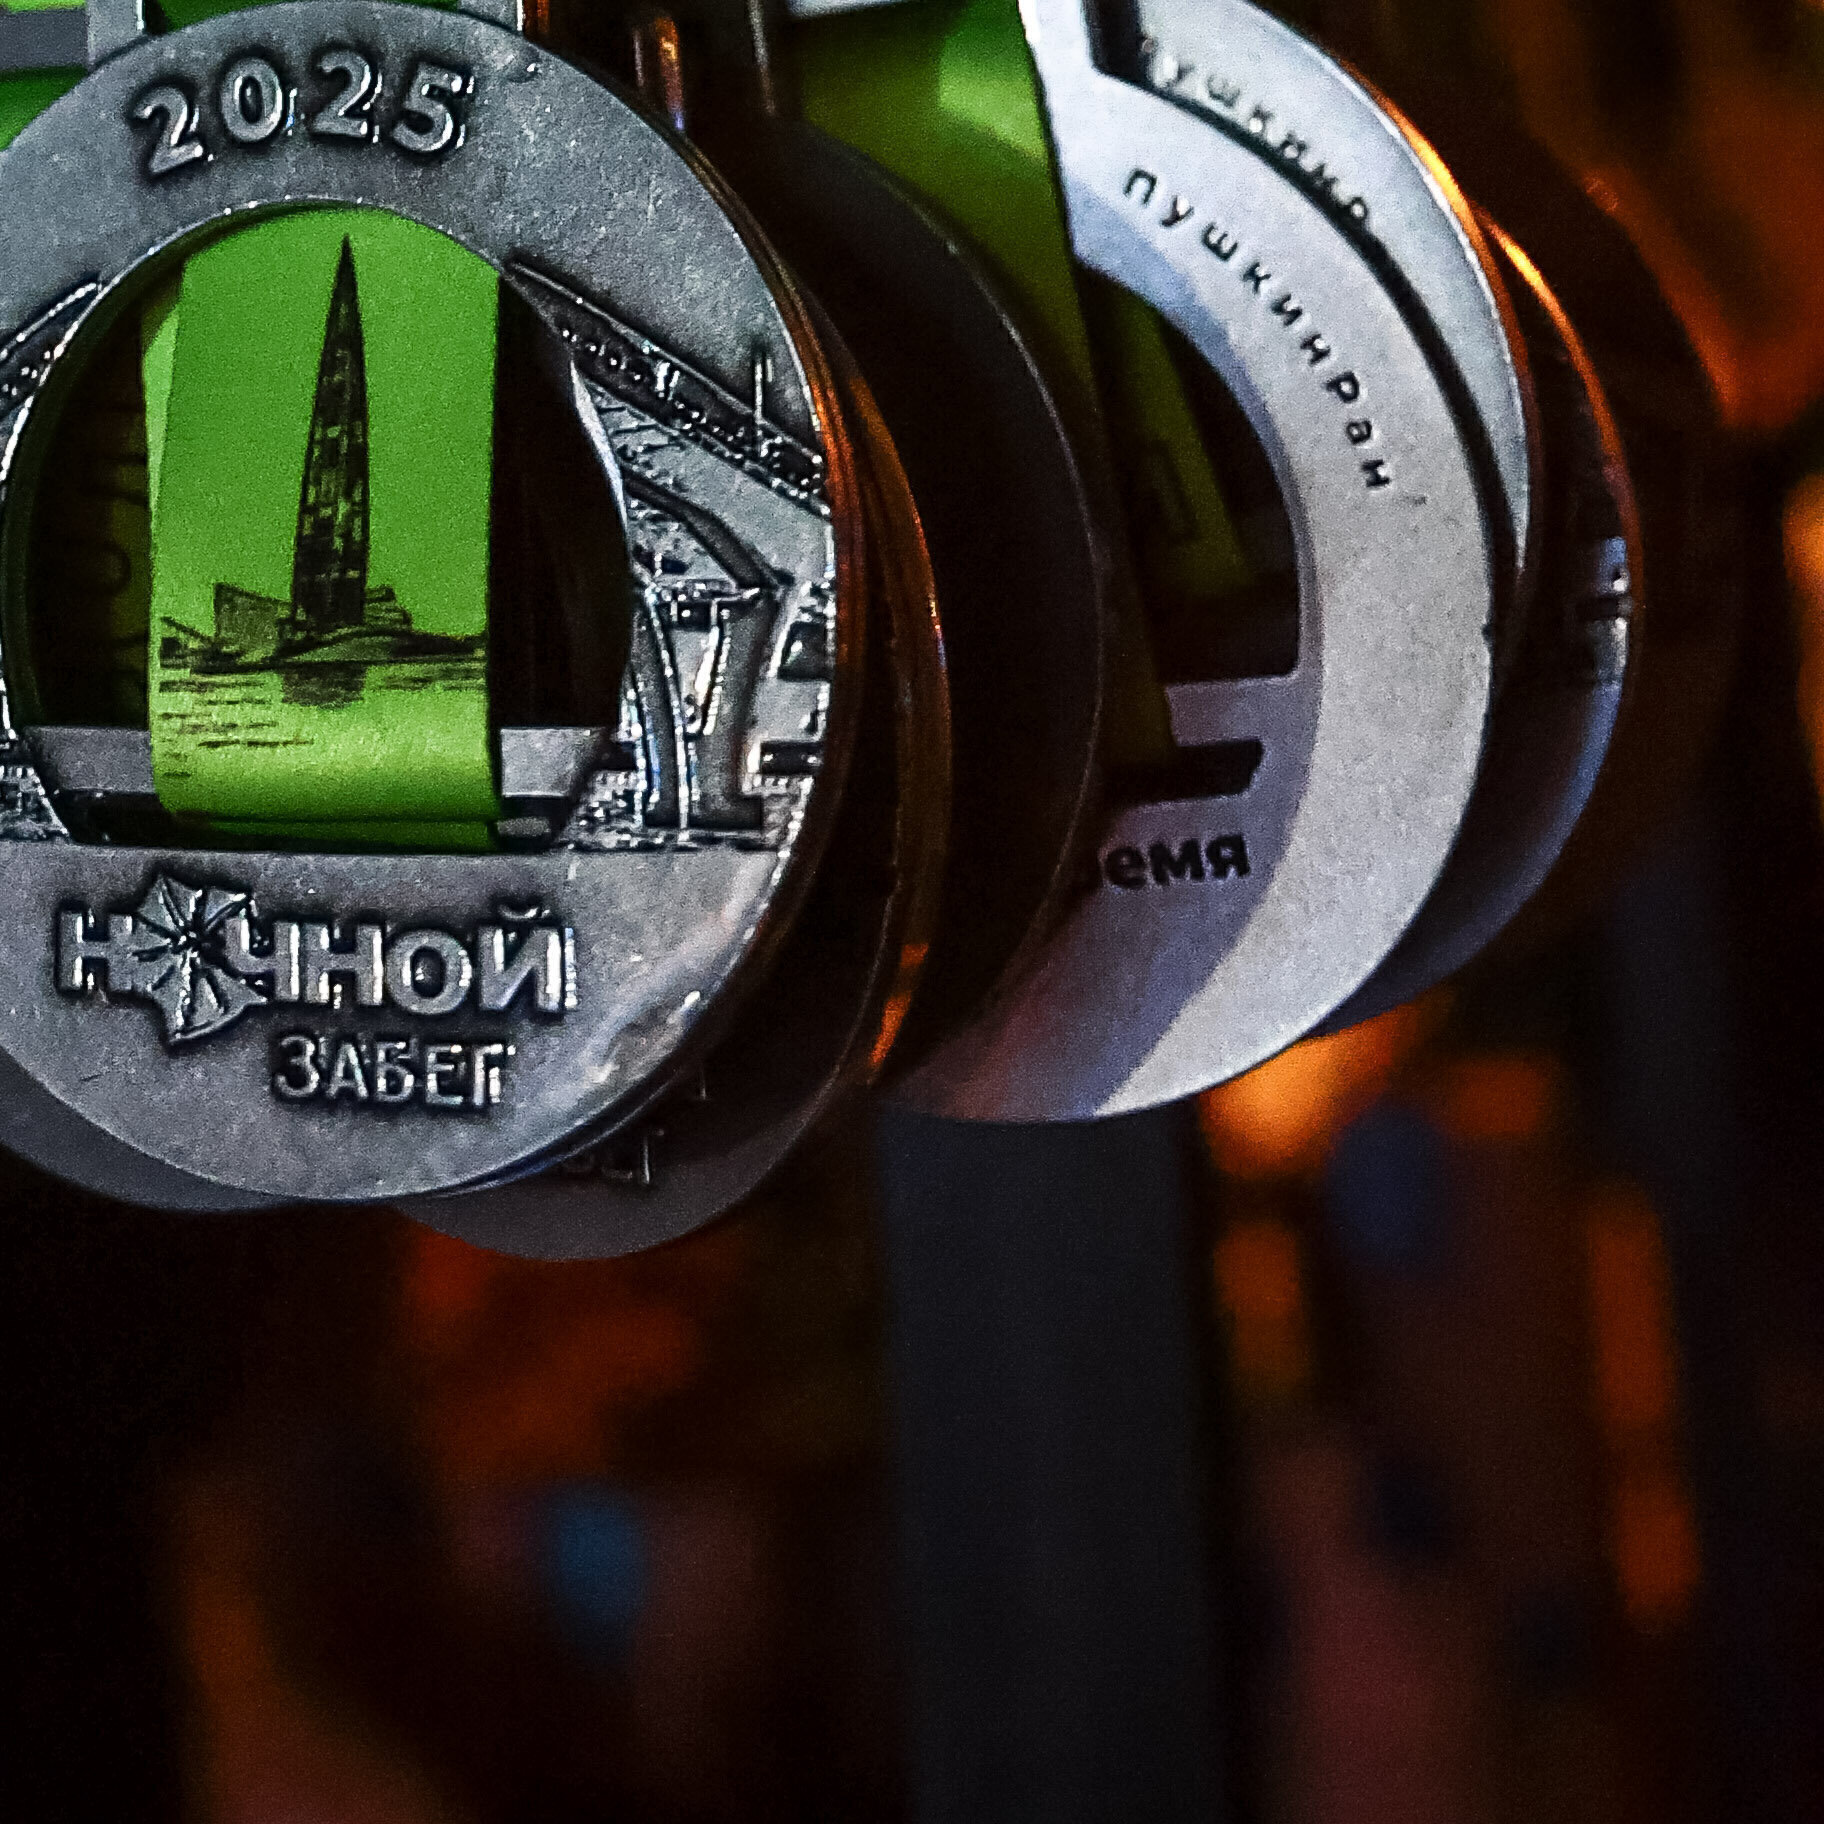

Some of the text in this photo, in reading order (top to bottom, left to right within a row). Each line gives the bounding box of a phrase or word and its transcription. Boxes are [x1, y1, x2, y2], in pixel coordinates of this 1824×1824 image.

[129, 44, 476, 179] 2025
[1102, 830, 1254, 890] емя
[274, 1028, 516, 1110] ЗАБЕГ
